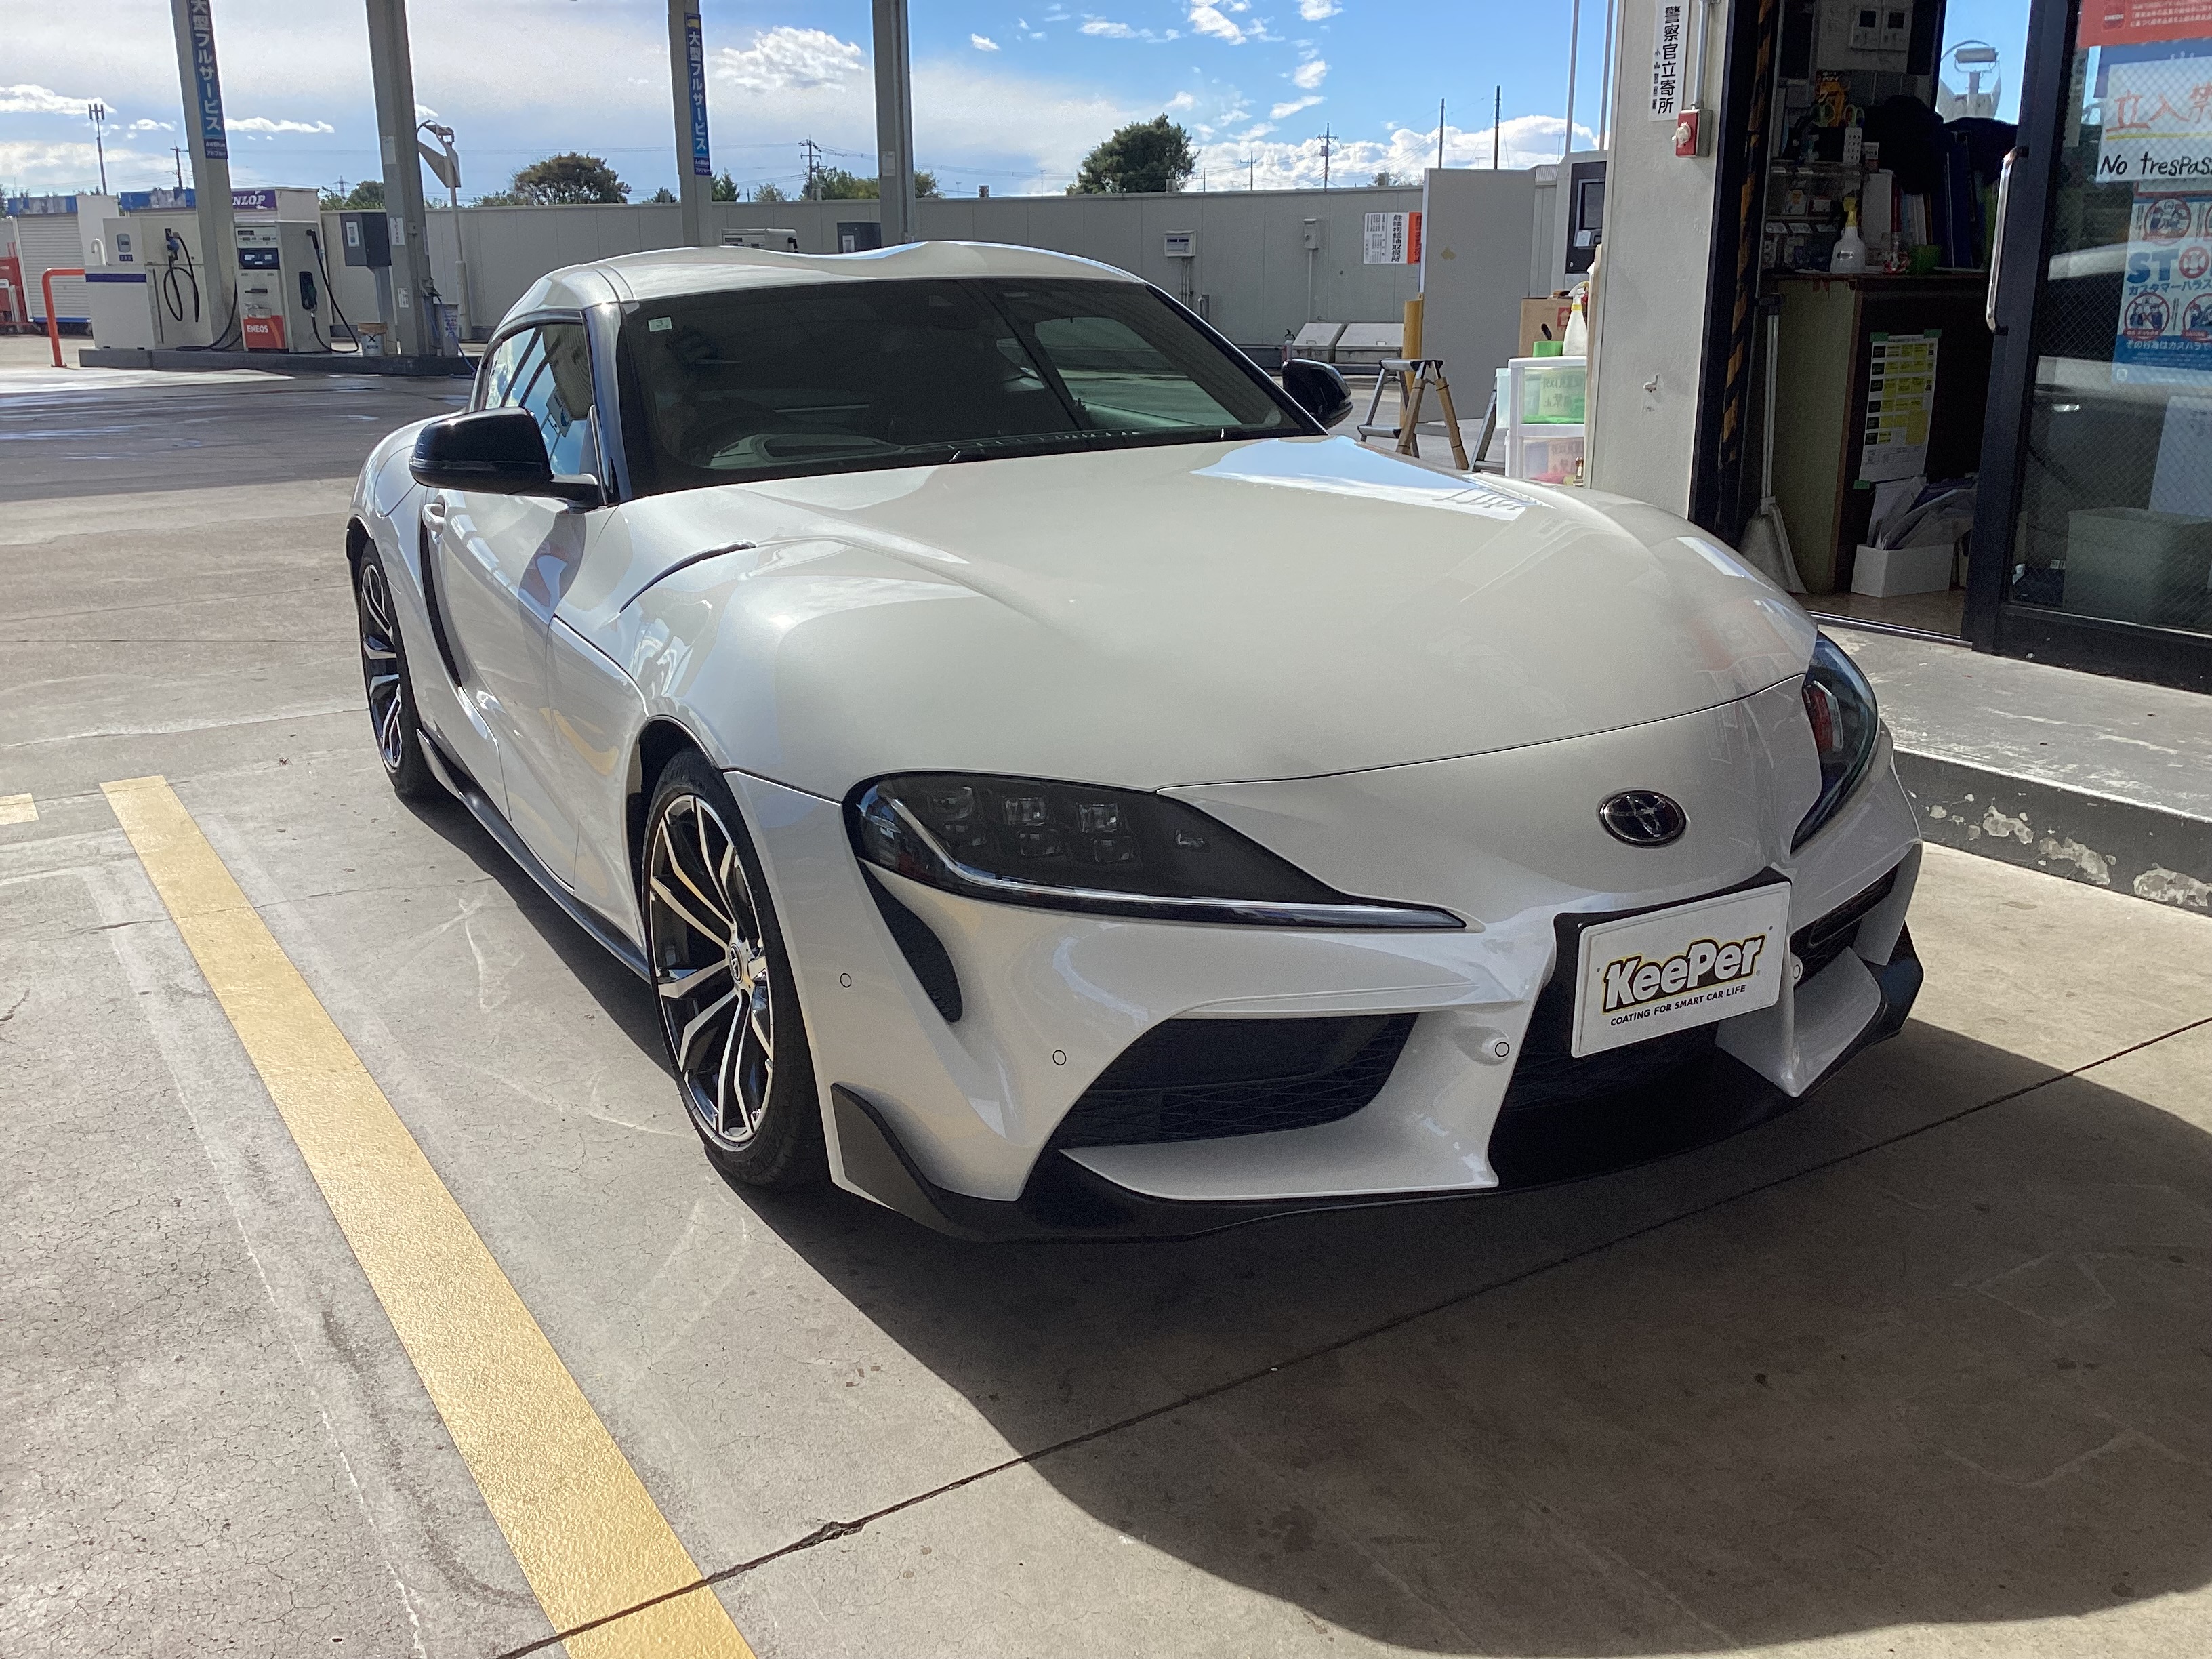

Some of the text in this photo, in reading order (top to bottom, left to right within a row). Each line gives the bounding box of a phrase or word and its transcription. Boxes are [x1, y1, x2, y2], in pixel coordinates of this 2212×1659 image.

[192, 0, 221, 131] 大型フルサービス
[688, 31, 707, 150] 大型フルサービス
[1658, 5, 1681, 115] 警察官立寄所
[2100, 154, 2127, 175] No
[247, 325, 268, 333] ENEOS
[1604, 935, 1765, 1012] KeePer
[1611, 984, 1746, 1026] COATING FOR SMART CAR LIFE
